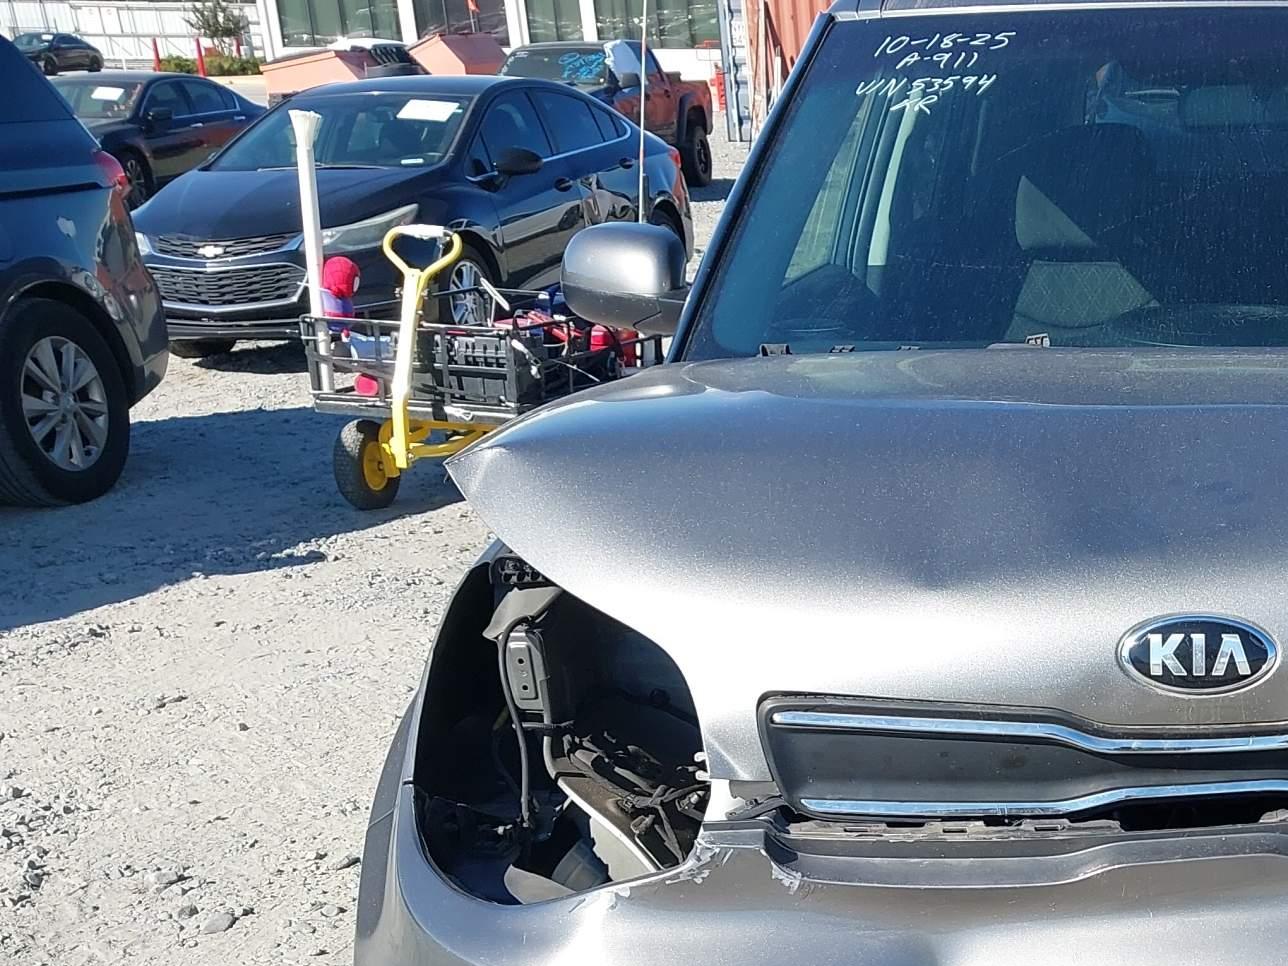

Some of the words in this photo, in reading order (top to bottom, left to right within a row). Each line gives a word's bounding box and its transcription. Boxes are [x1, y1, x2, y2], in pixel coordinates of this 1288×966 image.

[874, 31, 1017, 57] 10-18-25
[855, 77, 908, 97] VIN
[906, 73, 997, 96] 53594
[1148, 633, 1252, 677] KIA
